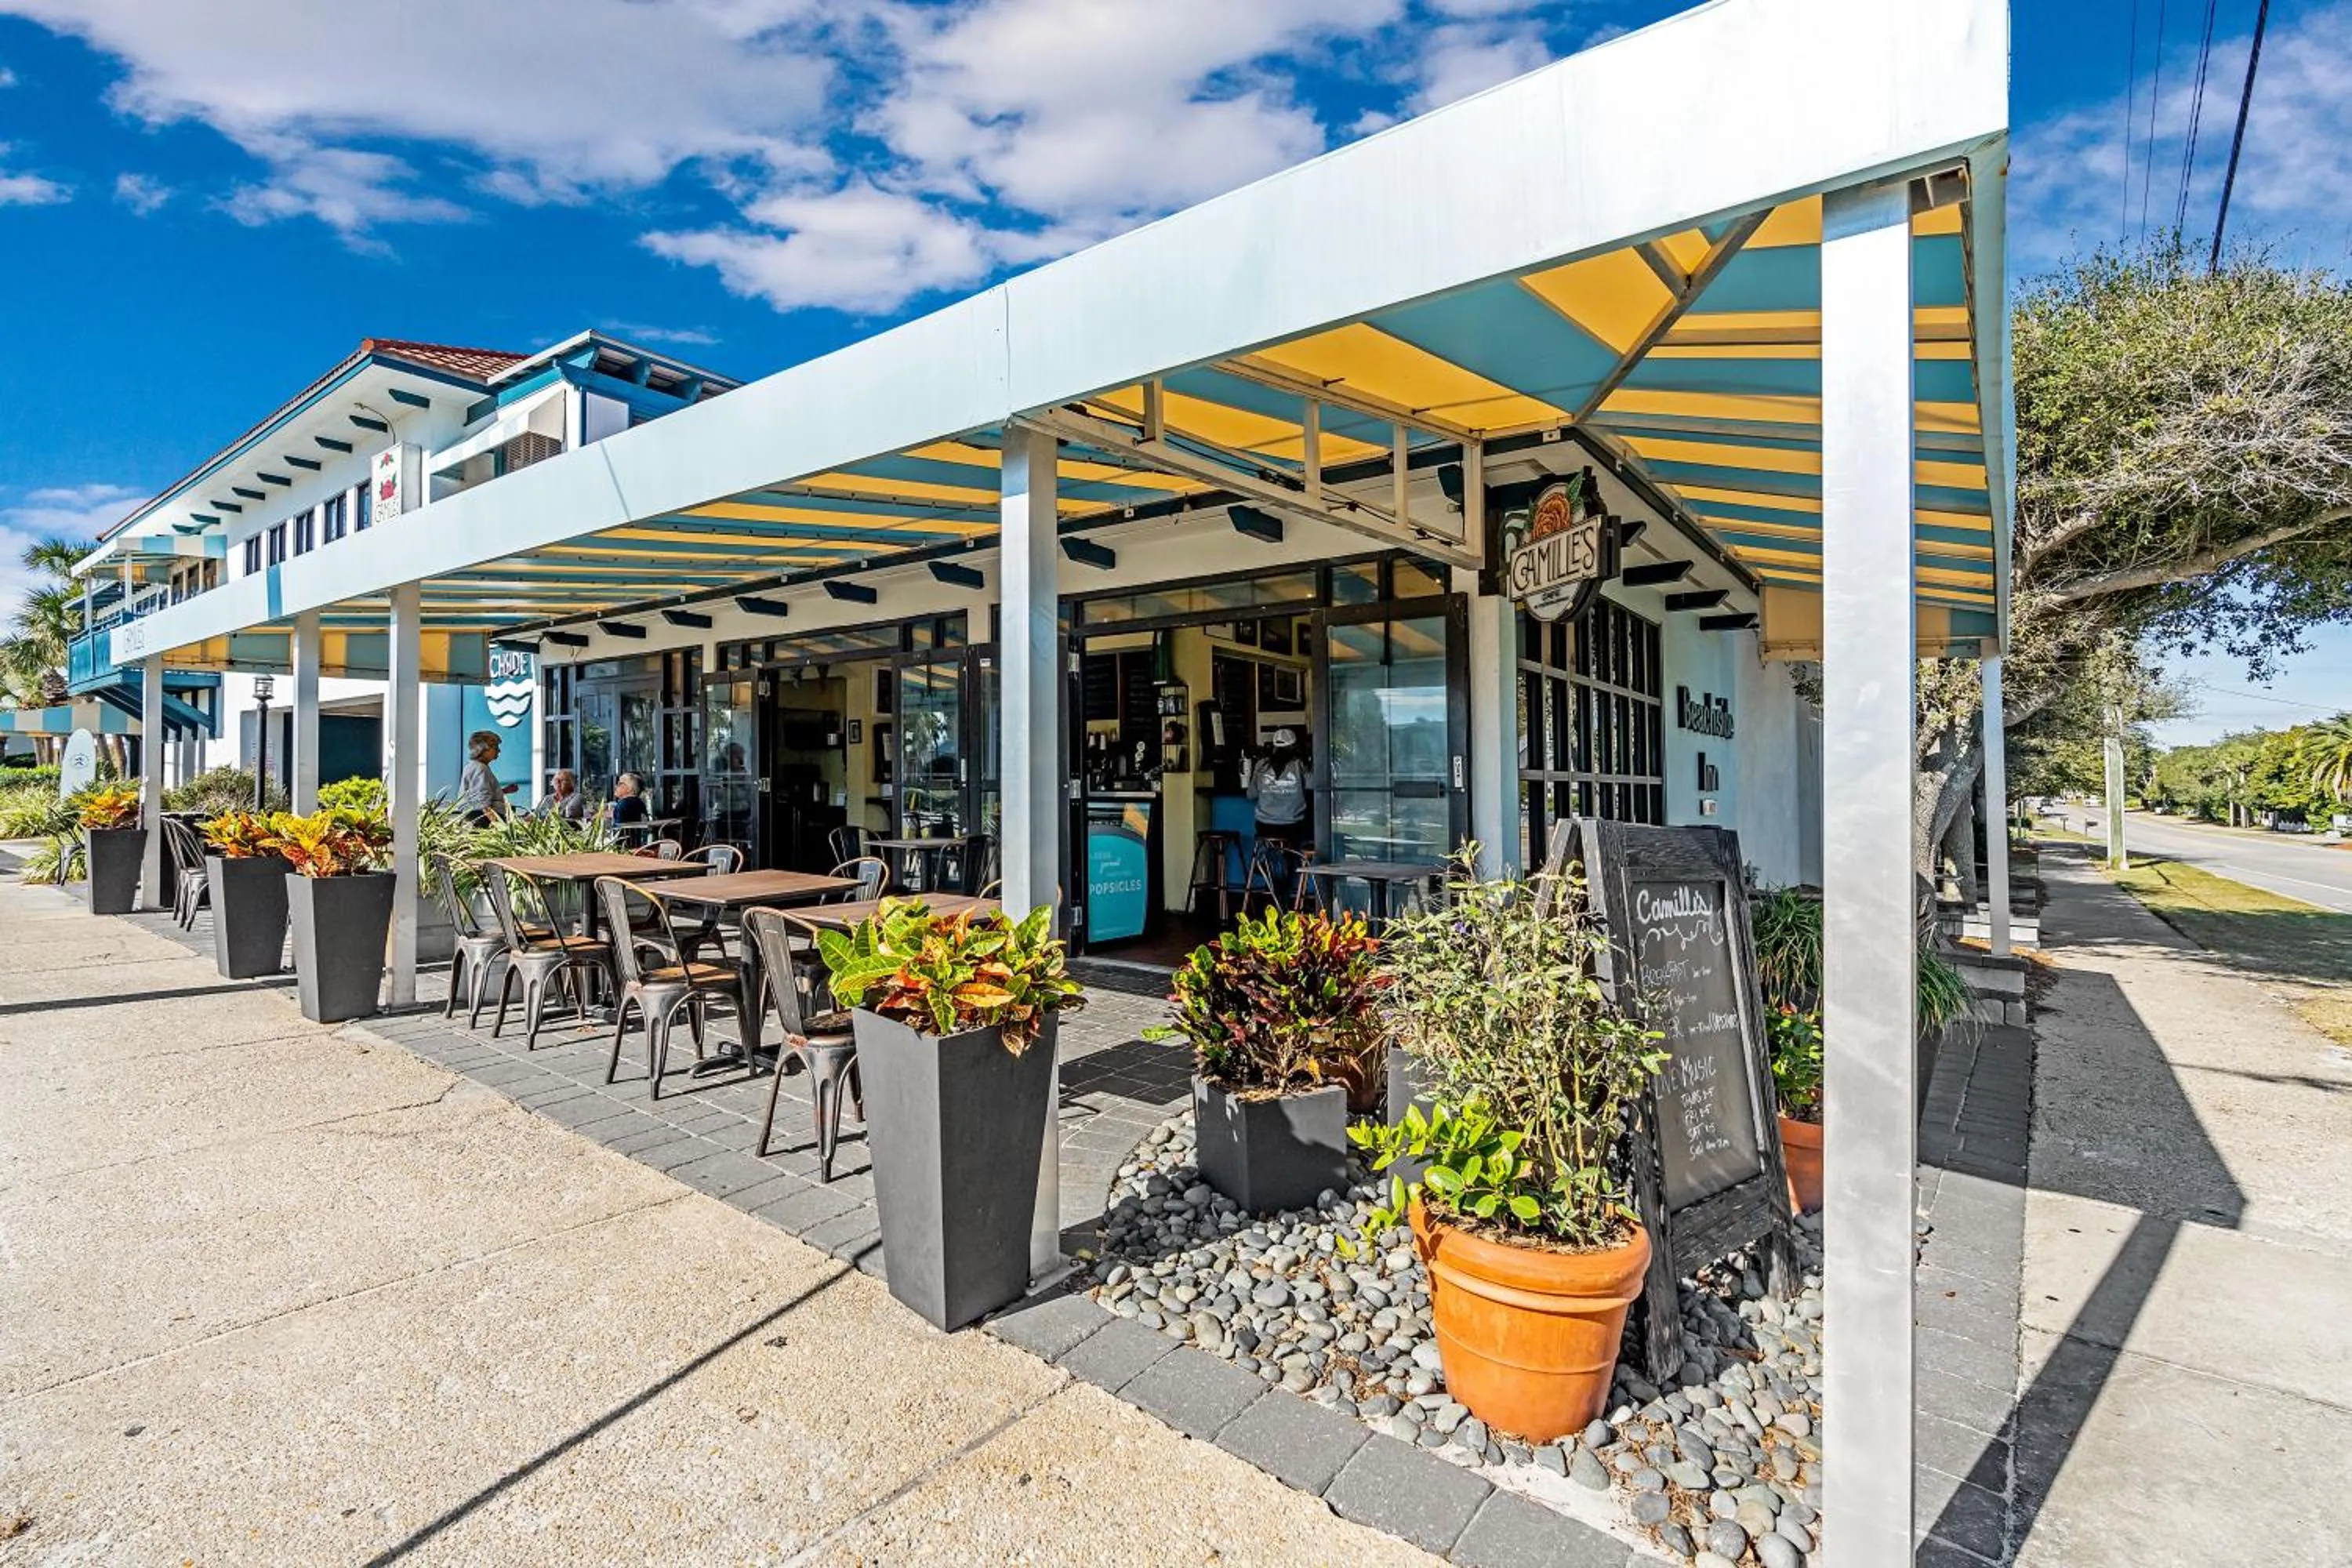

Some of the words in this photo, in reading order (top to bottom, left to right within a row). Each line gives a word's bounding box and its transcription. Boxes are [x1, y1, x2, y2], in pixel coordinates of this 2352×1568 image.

[1513, 527, 1595, 591] CAMILLE'S
[1090, 880, 1142, 895] POPSICLES
[1680, 1055, 1717, 1087] MUSIC
